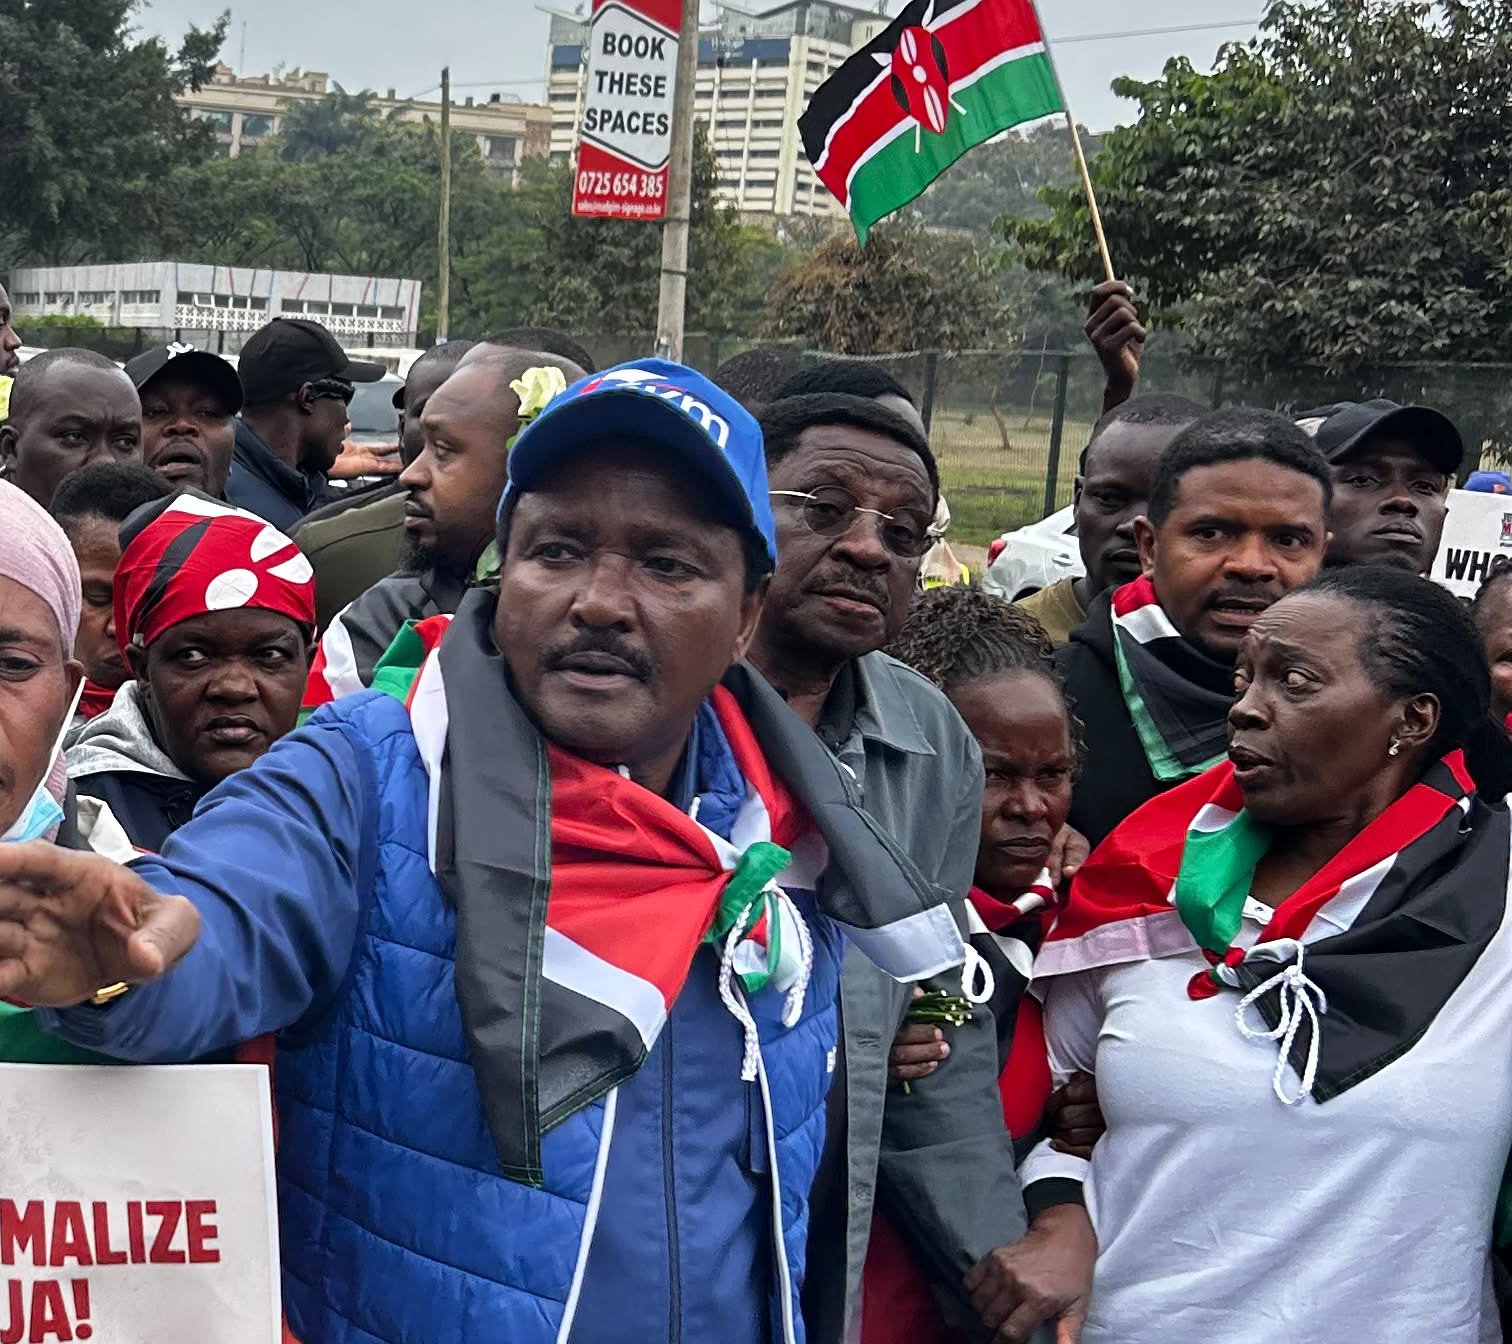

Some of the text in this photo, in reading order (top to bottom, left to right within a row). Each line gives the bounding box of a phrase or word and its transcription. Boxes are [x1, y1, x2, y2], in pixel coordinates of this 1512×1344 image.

[602, 32, 665, 61] BOOK
[595, 70, 666, 98] THESE
[584, 108, 669, 136] SPACES
[578, 171, 664, 198] 0725 654 385
